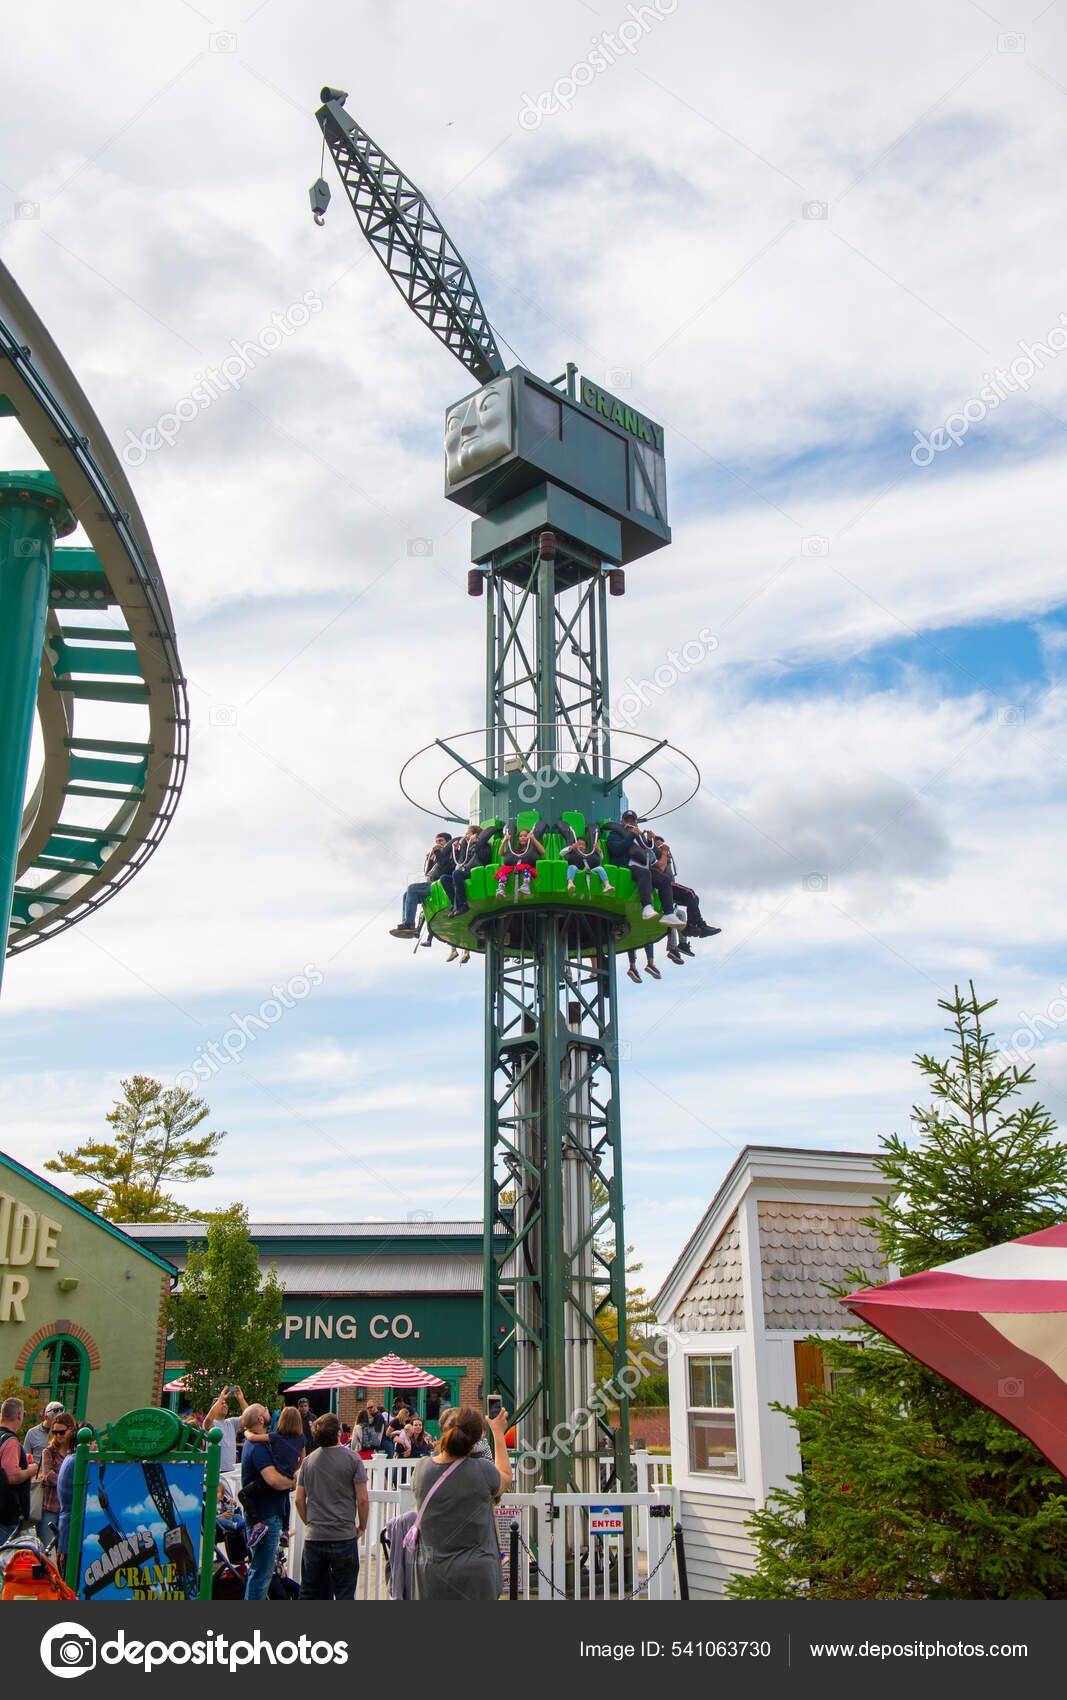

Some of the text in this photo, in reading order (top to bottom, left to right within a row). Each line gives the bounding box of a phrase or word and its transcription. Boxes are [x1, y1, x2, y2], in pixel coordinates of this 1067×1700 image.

[582, 383, 662, 450] CRANKY
[368, 1314, 421, 1340] CO.
[591, 1520, 622, 1528] ENTER
[84, 1530, 155, 1586] CRANKY'S
[114, 1563, 177, 1590] CRANE
